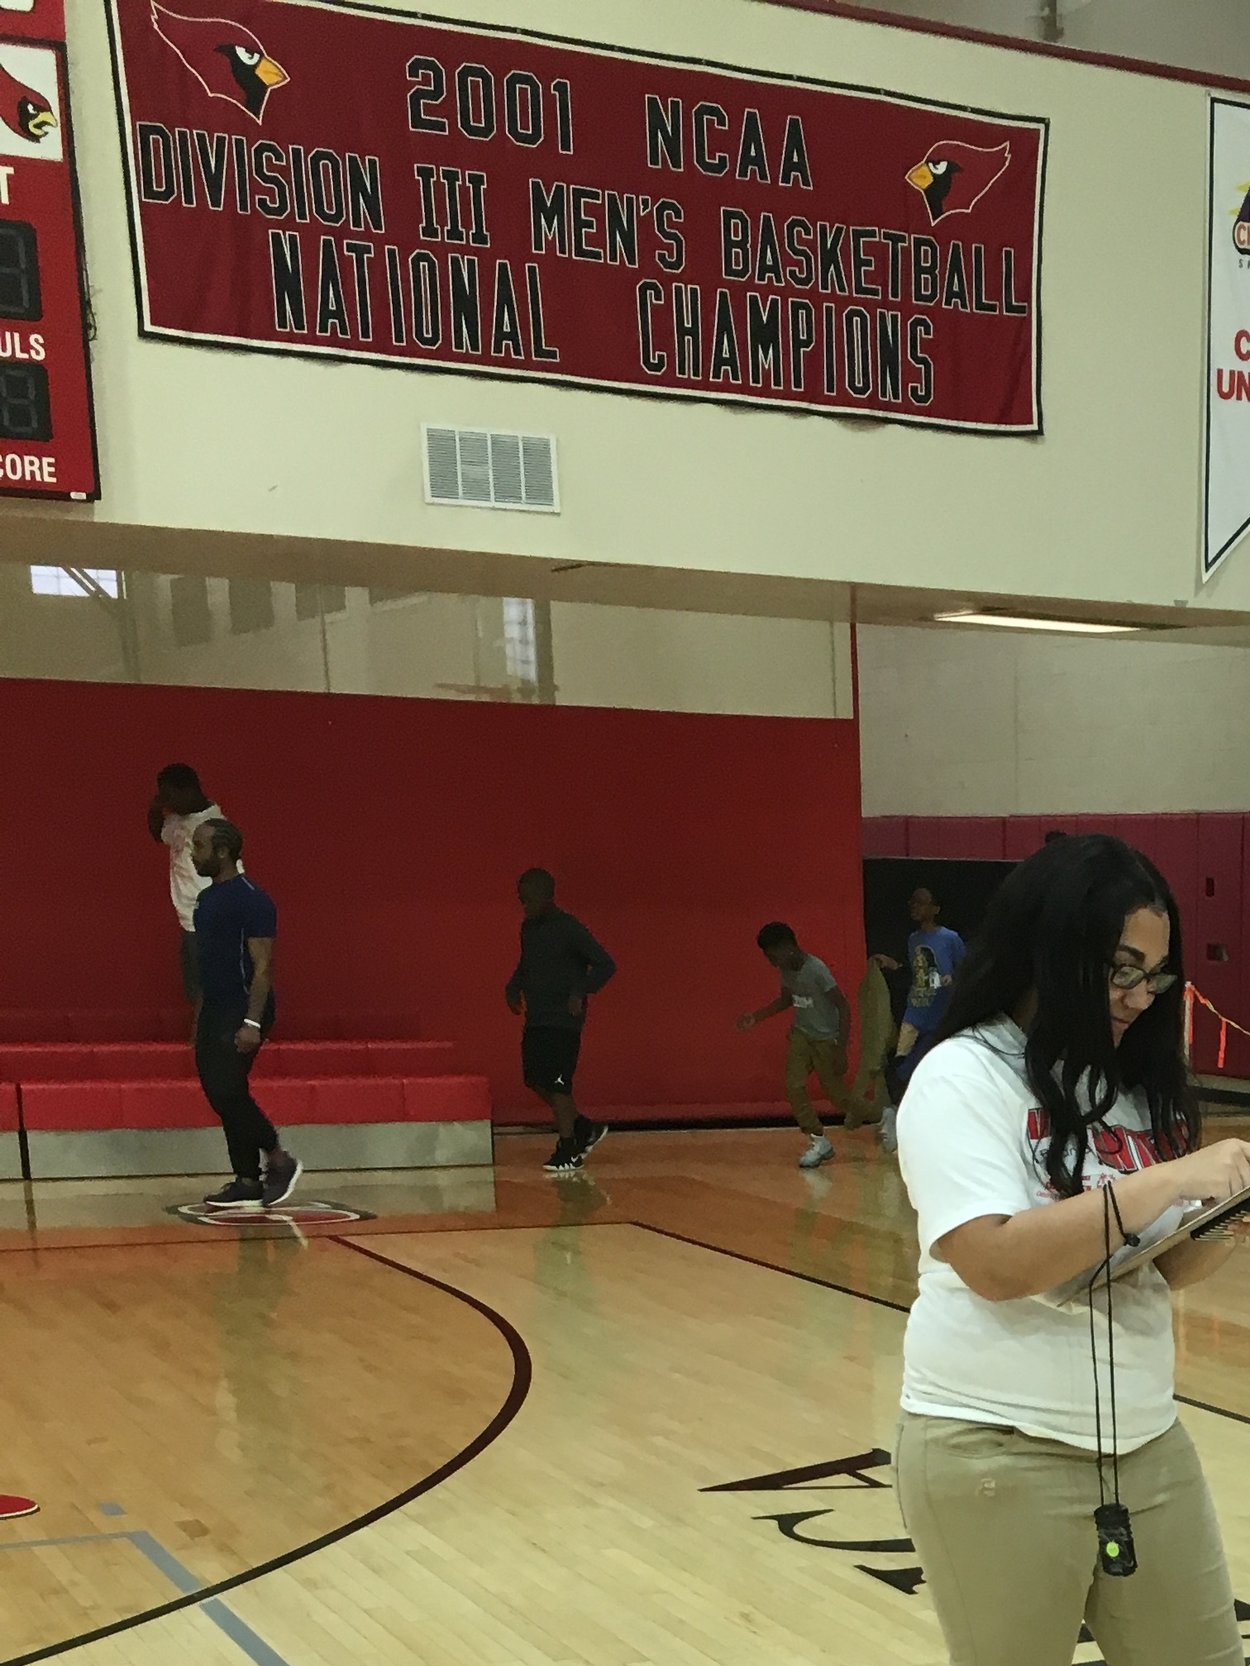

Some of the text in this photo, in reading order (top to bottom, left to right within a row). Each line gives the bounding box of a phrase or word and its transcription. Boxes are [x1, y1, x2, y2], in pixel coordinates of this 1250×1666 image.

[406, 56, 813, 190] 2001 NCAA
[137, 122, 1029, 316] DIVISION III MEN'S BASKETBALL
[269, 229, 934, 406] NATIONAL CHAMPIONS
